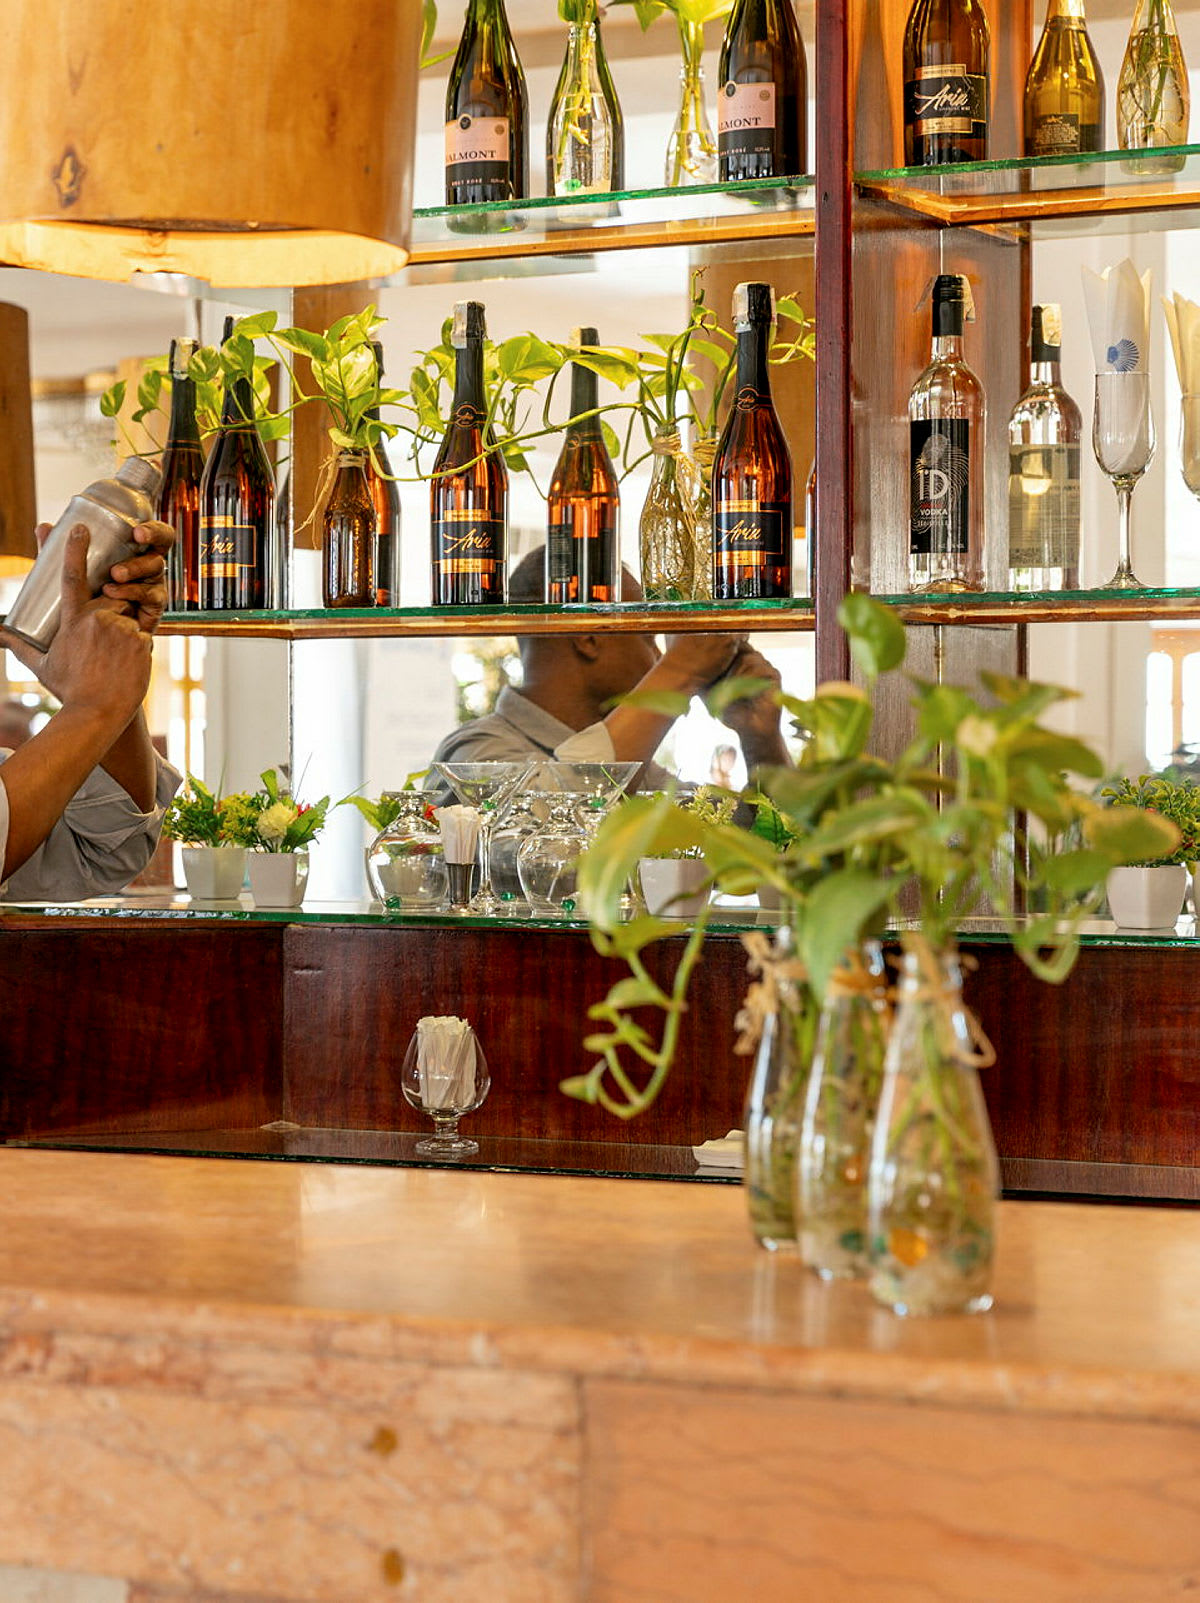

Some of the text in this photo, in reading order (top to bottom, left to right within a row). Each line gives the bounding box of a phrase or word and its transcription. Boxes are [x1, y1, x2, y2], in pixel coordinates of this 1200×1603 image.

[914, 83, 968, 115] Aria
[919, 508, 948, 516] VODKA
[442, 528, 492, 554] Aria
[717, 519, 762, 545] Aria
